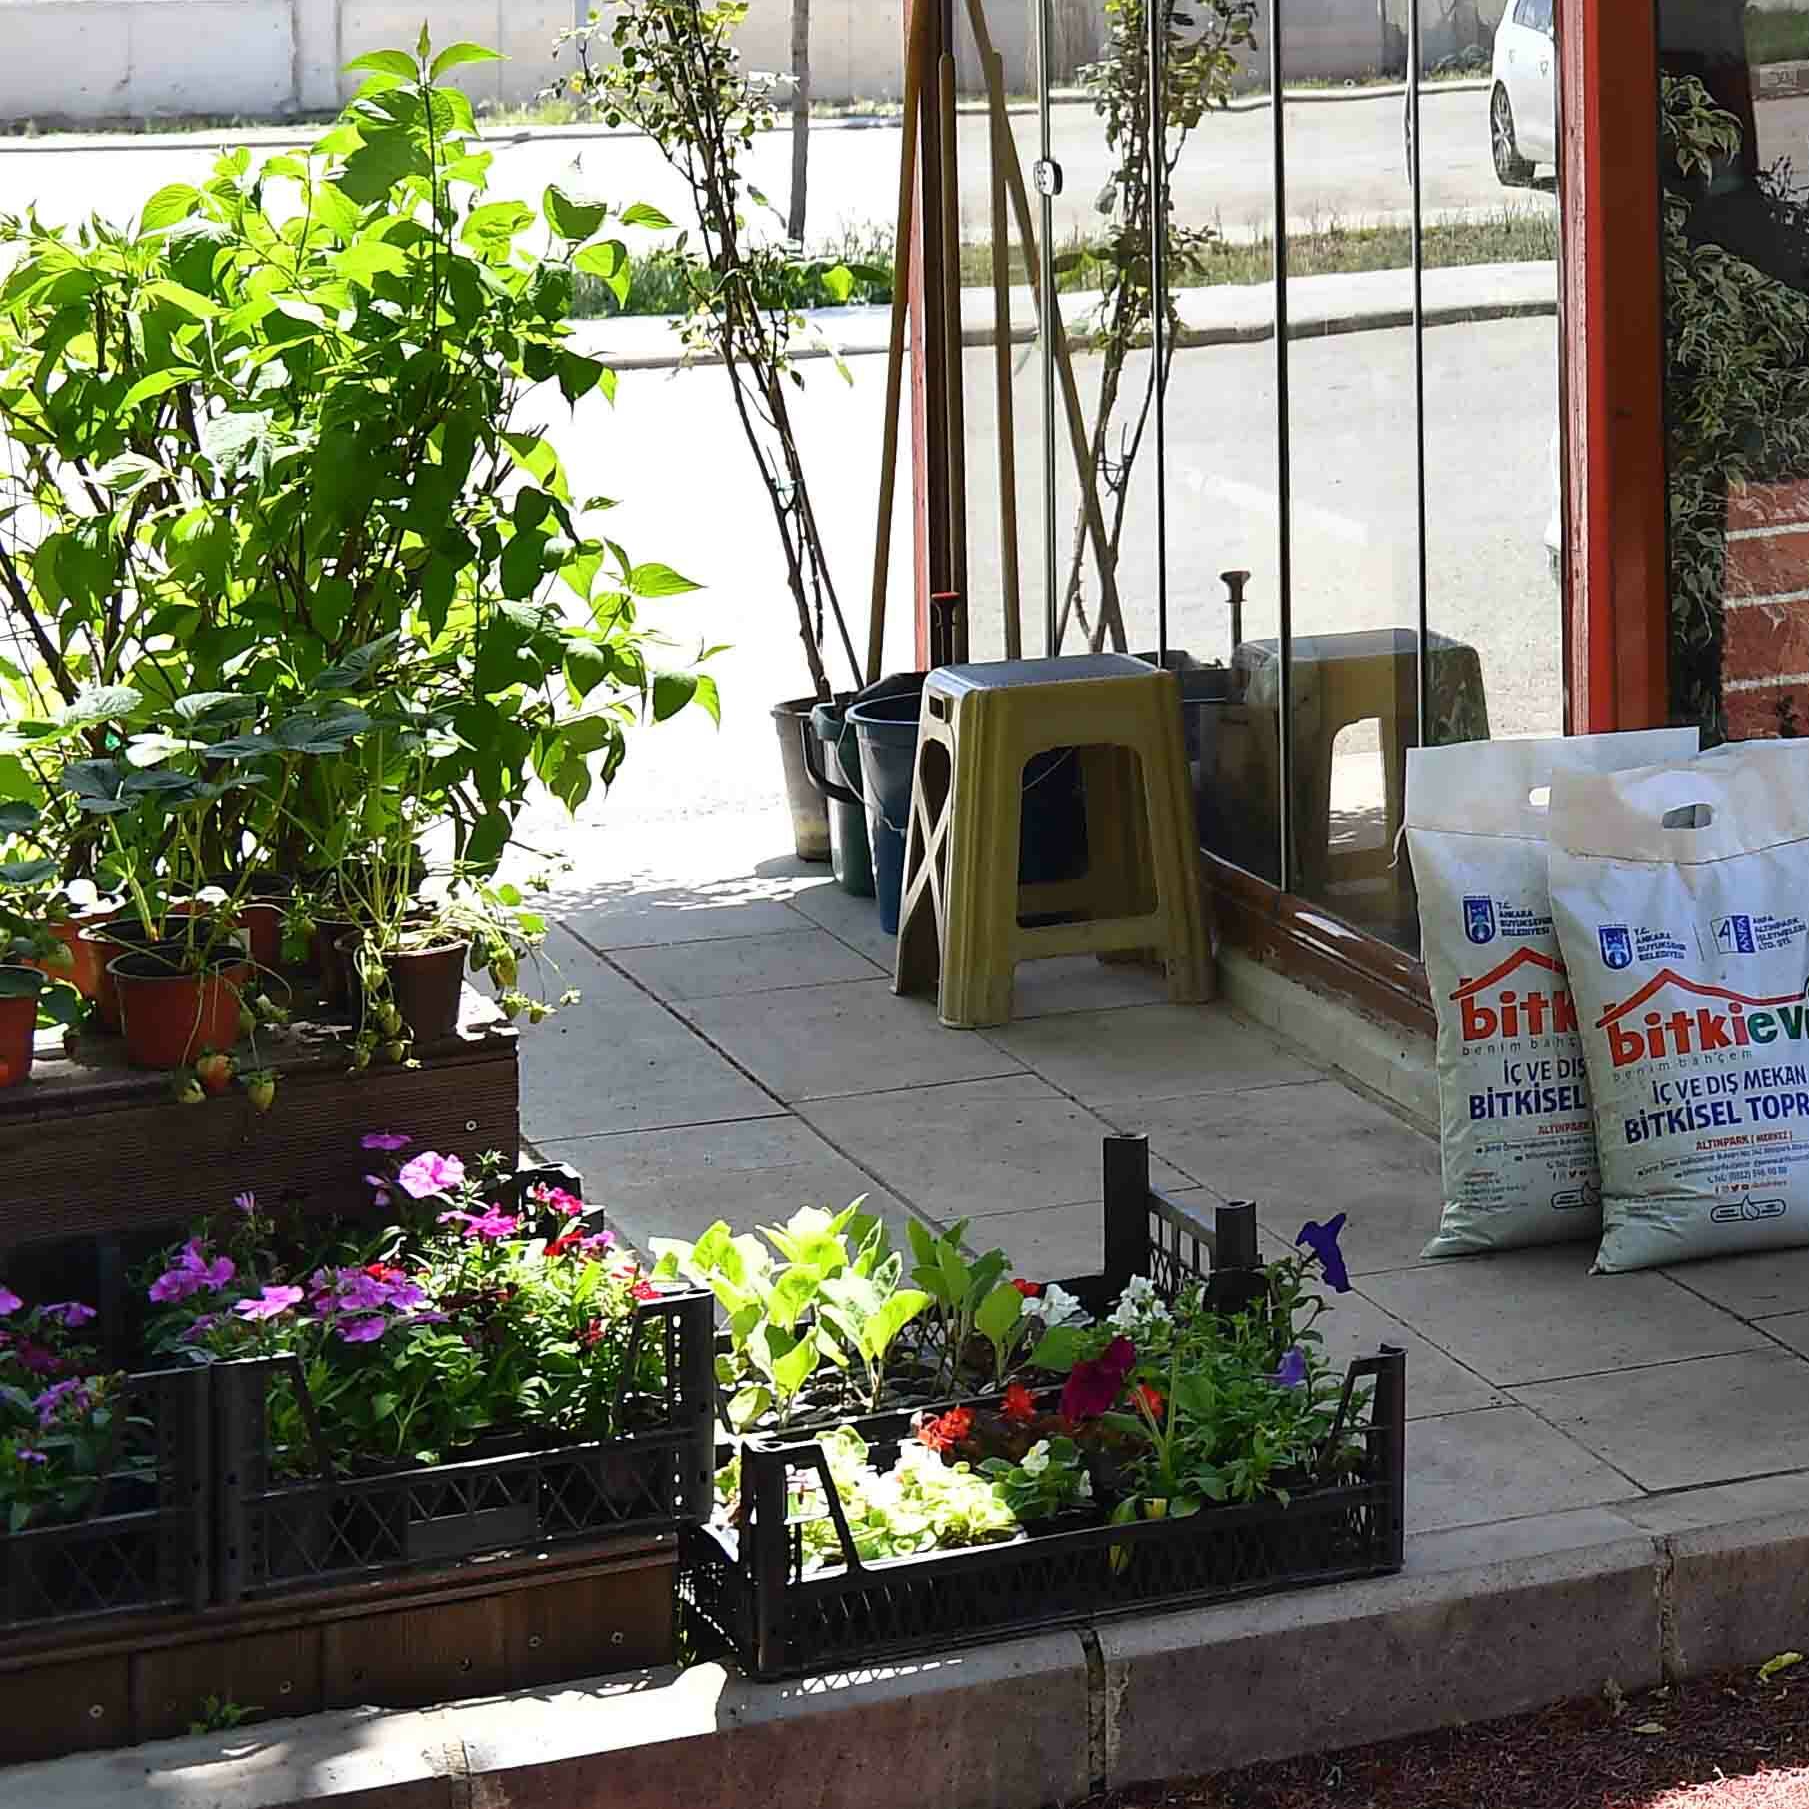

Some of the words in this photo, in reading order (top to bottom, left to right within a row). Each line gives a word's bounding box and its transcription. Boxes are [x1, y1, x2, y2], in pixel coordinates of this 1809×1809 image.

[1461, 1040, 1521, 1056] benim
[1503, 1059, 1523, 1086] İÇ
[1526, 1060, 1552, 1082] VE
[1652, 1079, 1673, 1105] İÇ
[1675, 1077, 1703, 1098] VE
[1707, 1073, 1739, 1096] DIŞ
[1743, 1064, 1808, 1091] MEKAN
[1469, 1081, 1588, 1120] BİTKİSEL
[1624, 1097, 1743, 1144] BİTKİSEL
